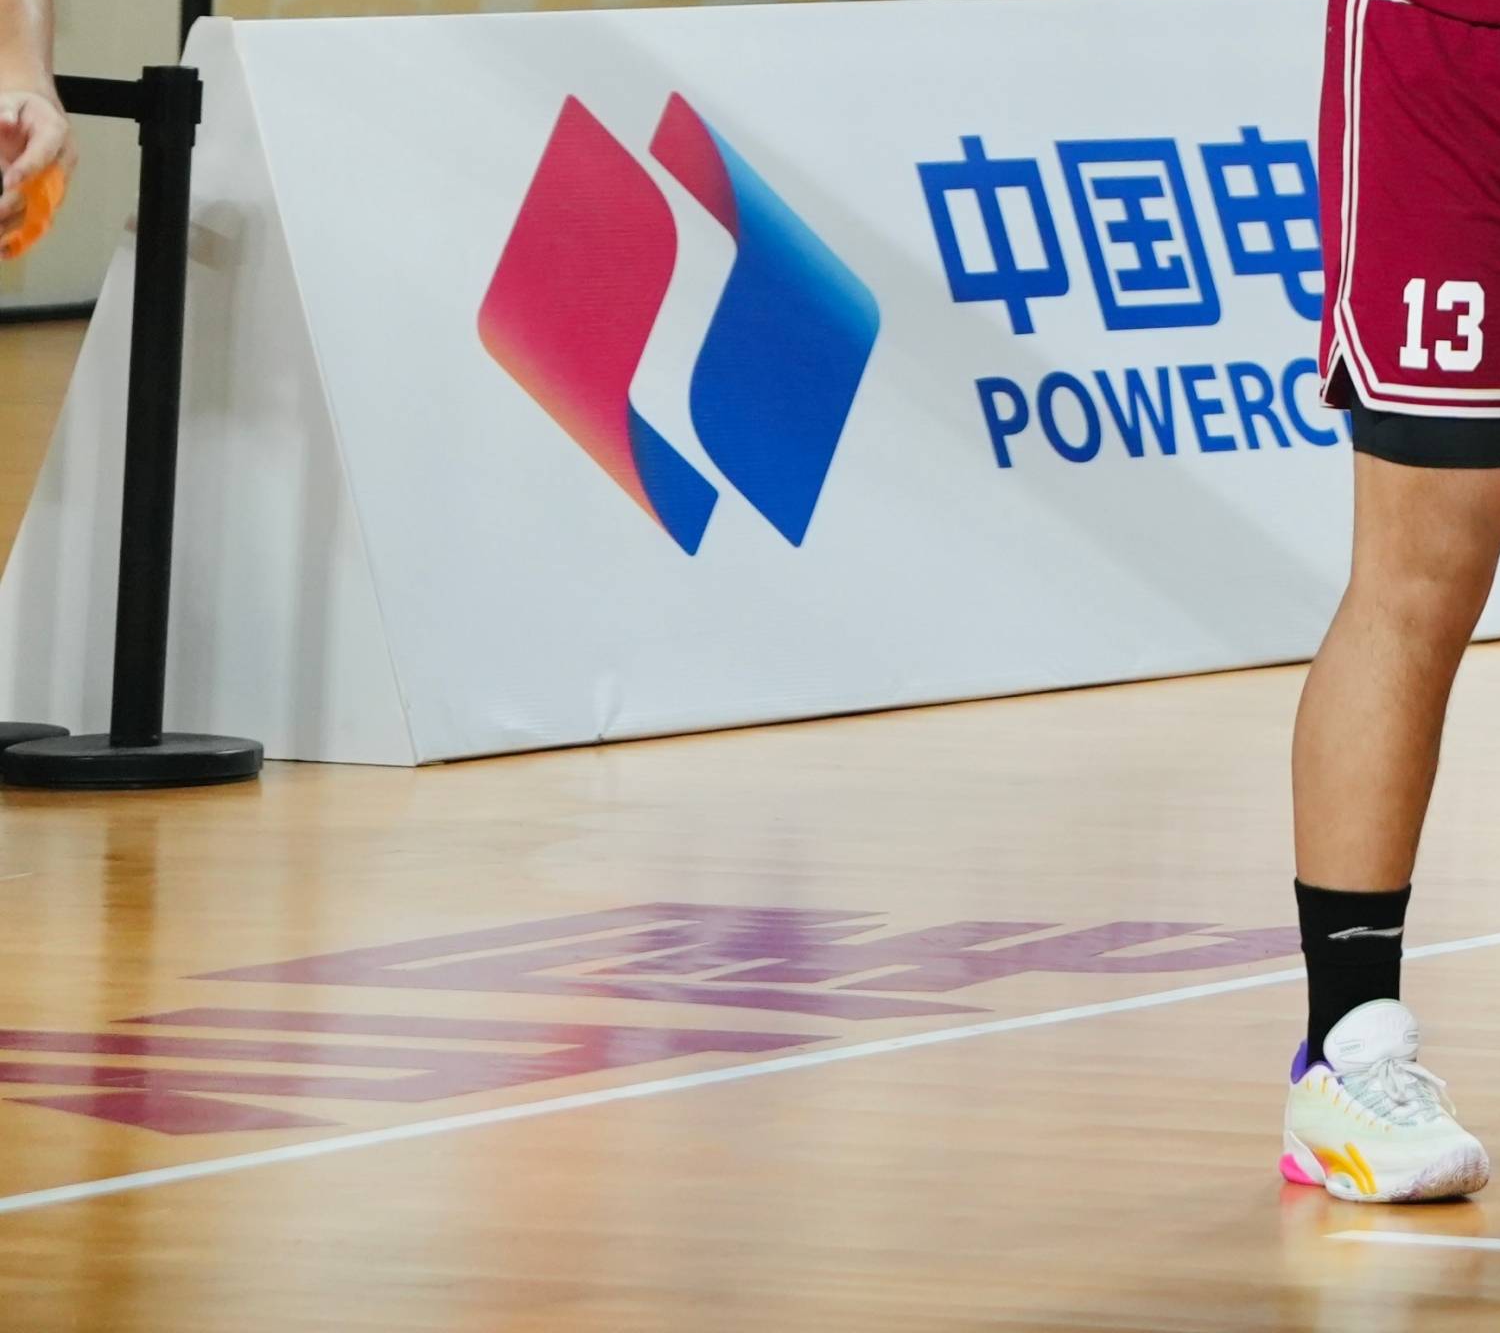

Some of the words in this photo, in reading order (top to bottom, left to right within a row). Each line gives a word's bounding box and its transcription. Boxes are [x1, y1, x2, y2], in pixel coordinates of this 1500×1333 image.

[914, 125, 1327, 336] 中国电
[1399, 277, 1486, 372] 13
[974, 357, 1352, 470] POWERC
